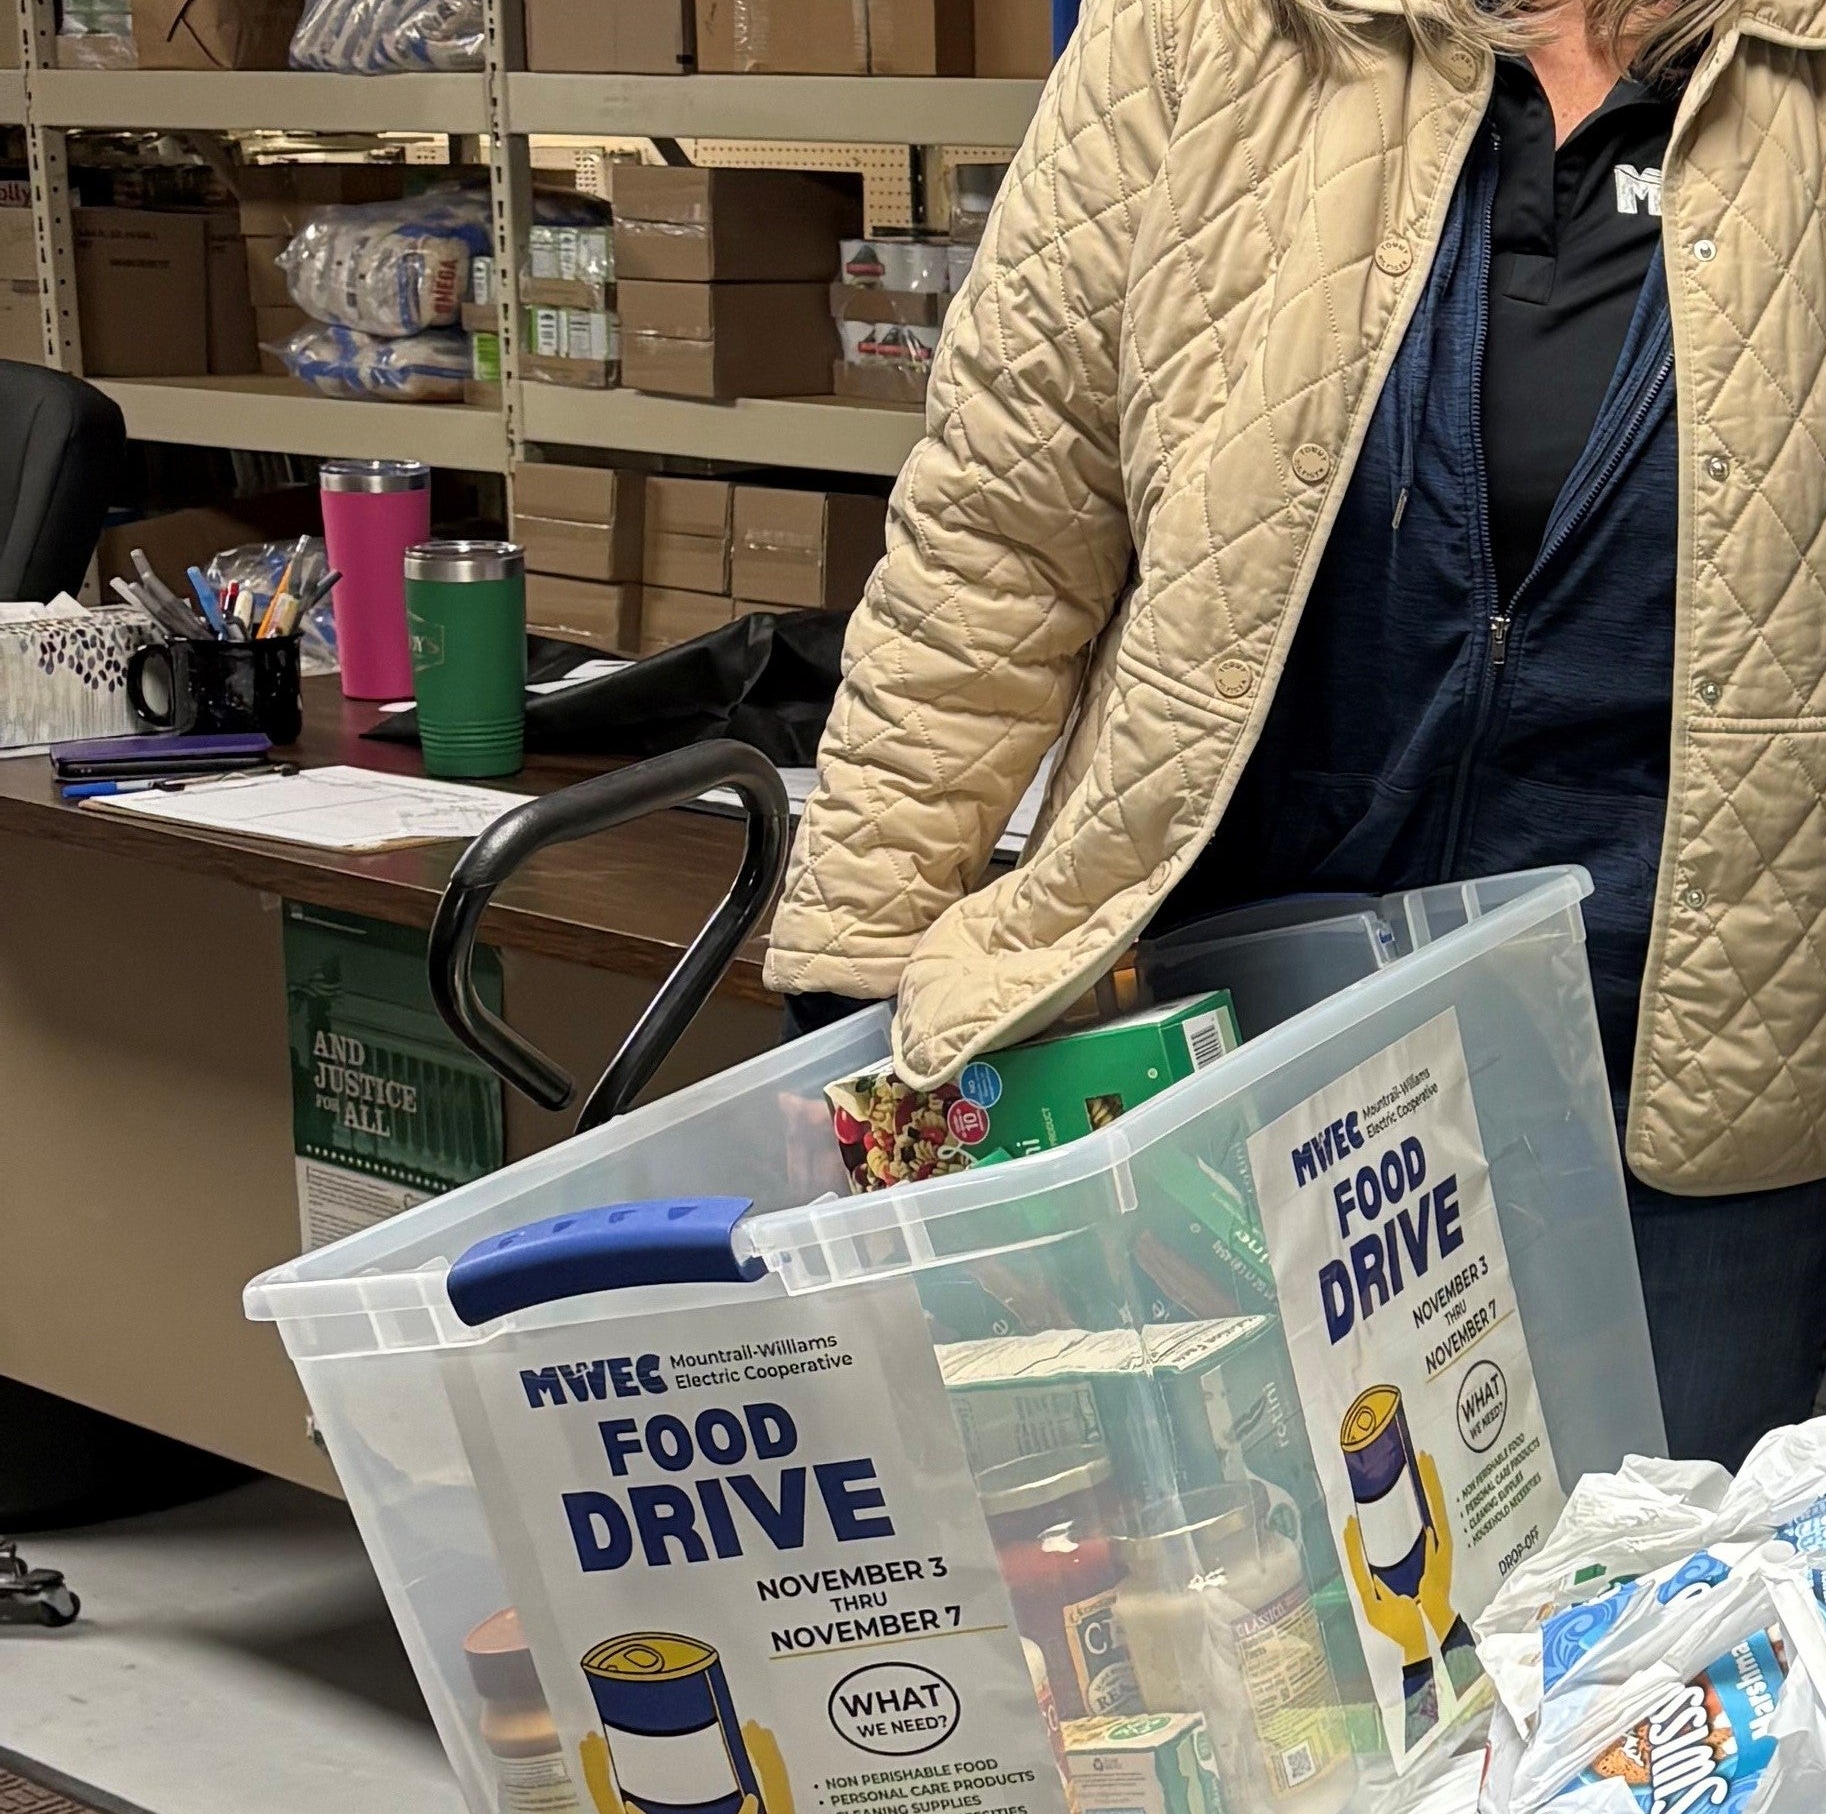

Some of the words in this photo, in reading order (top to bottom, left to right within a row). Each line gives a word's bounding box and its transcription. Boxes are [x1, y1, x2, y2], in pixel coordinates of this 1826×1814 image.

[313, 1031, 366, 1067] AND
[314, 1062, 417, 1114] JUSTICE
[1366, 1110, 1397, 1139] Electric
[1396, 1081, 1439, 1121] Cooperative
[316, 1093, 340, 1114] FOR
[344, 1101, 391, 1137] ALL
[1291, 1110, 1365, 1187] MWEC
[1333, 1136, 1427, 1239] FOOD
[1318, 1173, 1465, 1346] DRIVE
[1412, 1263, 1480, 1329] NOVEMBER
[1478, 1255, 1489, 1275] 3
[1443, 1301, 1467, 1326] THRU
[1425, 1309, 1490, 1375] NOVEMBER
[1488, 1299, 1497, 1319] 7
[519, 1354, 669, 1409] MWEC
[670, 1335, 838, 1369] Mountrail-Williams
[675, 1368, 741, 1390] Electric
[744, 1352, 853, 1382] Cooperative
[1461, 1373, 1500, 1424] WHAT
[598, 1402, 798, 1477] FOOD
[561, 1458, 896, 1573] DRIVE
[1498, 1524, 1540, 1577] DROP-OFF
[756, 1560, 924, 1601] NOVEMBER
[928, 1556, 948, 1578] 3
[830, 1591, 888, 1613] THRU
[771, 1609, 941, 1652] NOVEMBER
[944, 1605, 961, 1627] 7
[839, 1683, 941, 1718] WHAT
[1730, 1638, 1780, 1740] Marshma
[856, 1722, 888, 1738] WE
[890, 1715, 948, 1734] NEED?
[825, 1776, 859, 1790] NON
[862, 1764, 952, 1787] PERISHABLE
[954, 1758, 998, 1773] FOOD
[831, 1787, 908, 1806] PERSONAL
[911, 1782, 948, 1797] CARE
[950, 1770, 1035, 1792] PRODUCTS
[912, 1795, 982, 1814] SUPPLIES
